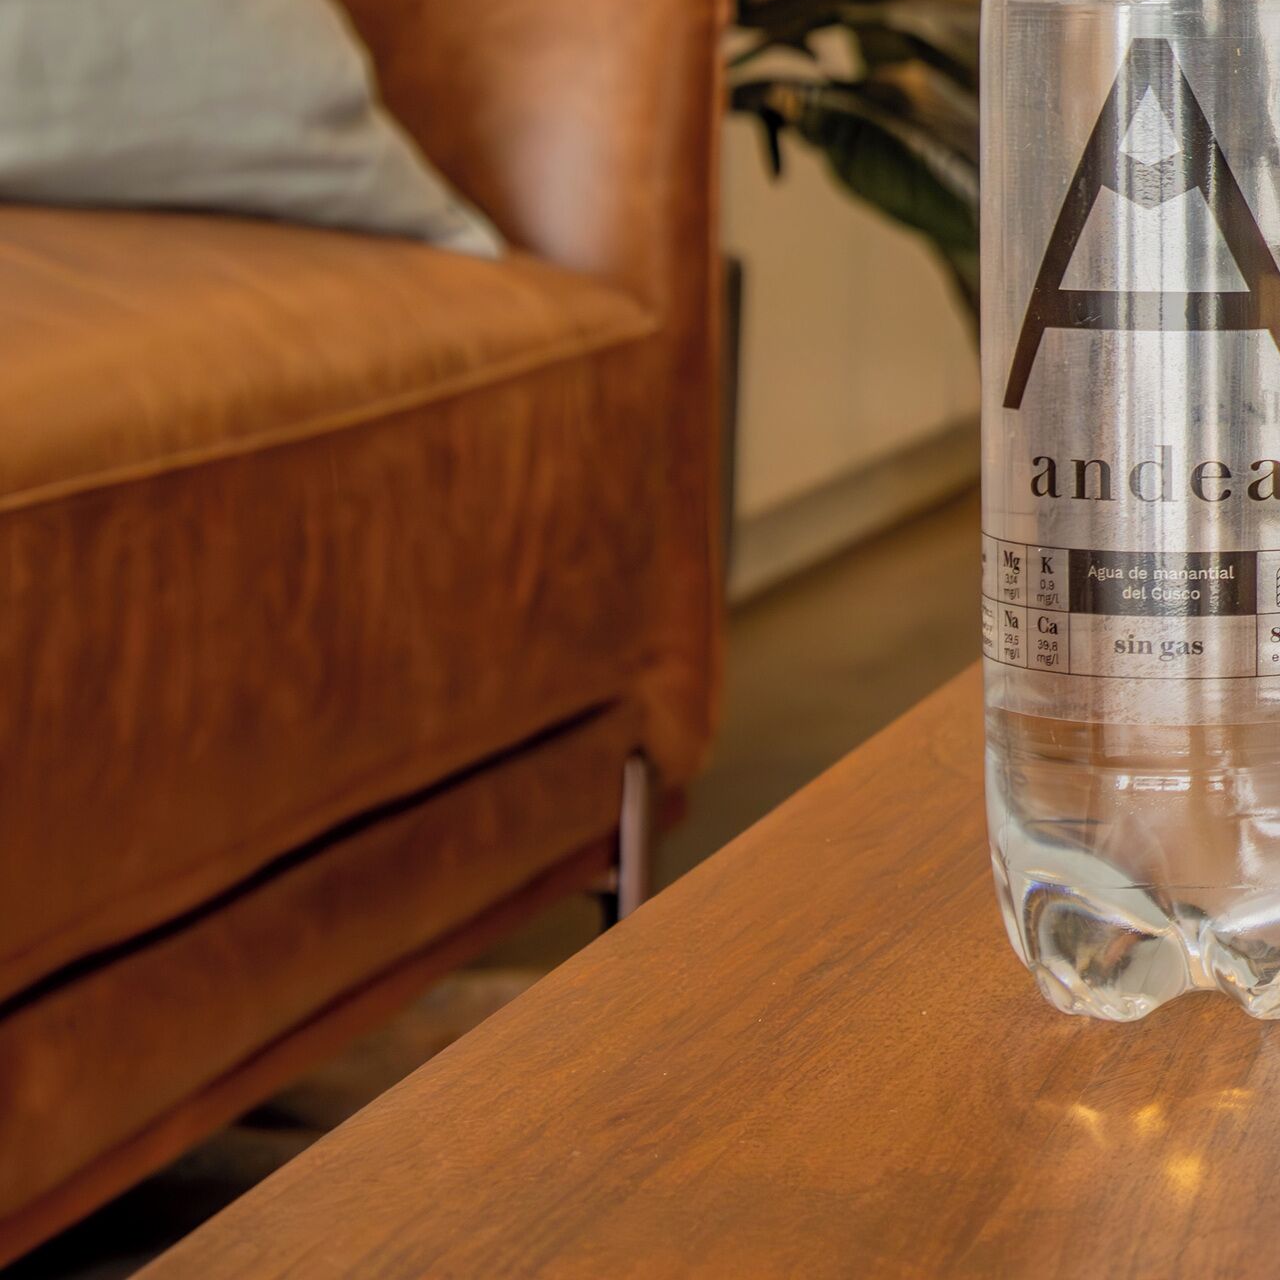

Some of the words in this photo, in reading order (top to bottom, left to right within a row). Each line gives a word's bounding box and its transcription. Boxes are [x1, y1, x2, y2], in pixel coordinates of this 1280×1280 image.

[1003, 550, 1020, 574] Mg
[1041, 556, 1054, 574] K
[1087, 565, 1124, 581] Agua
[1128, 566, 1148, 580] de
[1153, 565, 1235, 580] manantial
[1037, 593, 1059, 606] mg/l
[1122, 586, 1146, 600] del
[1152, 587, 1201, 601] Cusco
[1004, 610, 1020, 629] Na
[1037, 616, 1058, 635] Ca
[1037, 639, 1058, 652] 39,8
[1114, 634, 1153, 655] sin
[1159, 640, 1204, 662] gas
[1037, 653, 1059, 666] mg/l
